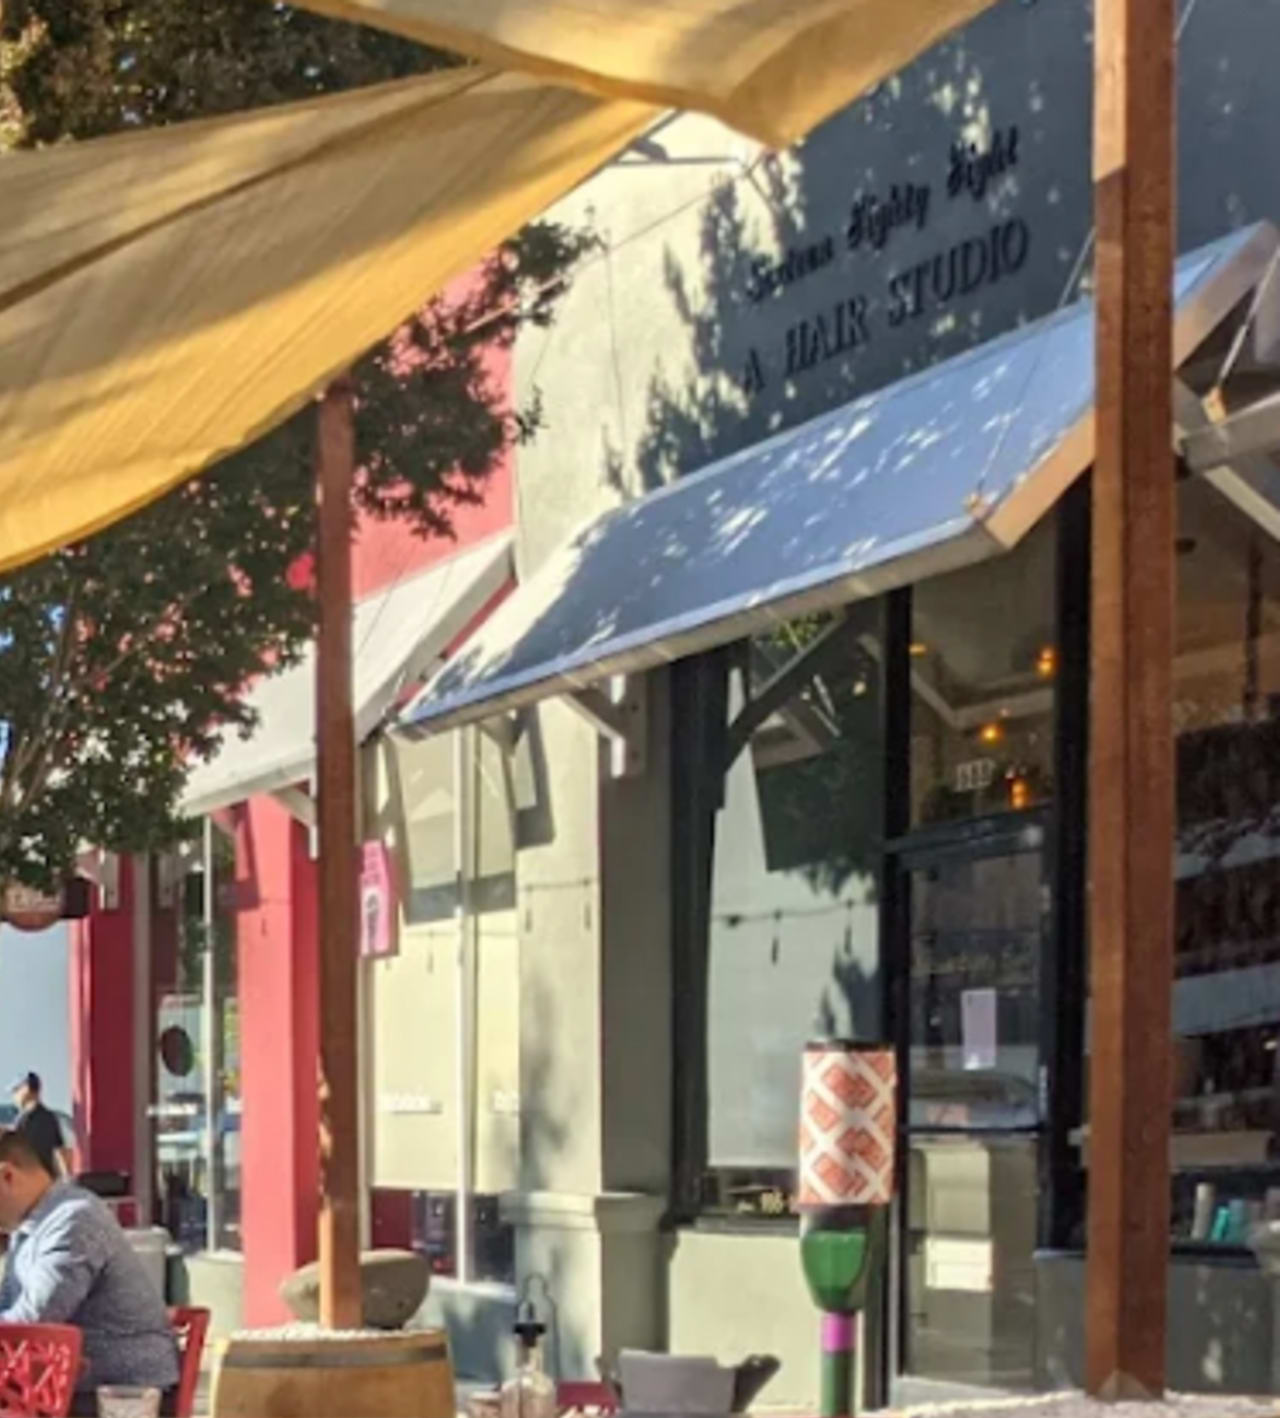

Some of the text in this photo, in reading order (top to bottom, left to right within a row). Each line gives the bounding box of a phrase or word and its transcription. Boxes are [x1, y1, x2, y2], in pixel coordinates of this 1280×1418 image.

[743, 347, 766, 392] A
[785, 295, 870, 378] HAIR
[888, 215, 1029, 328] STUDIO
